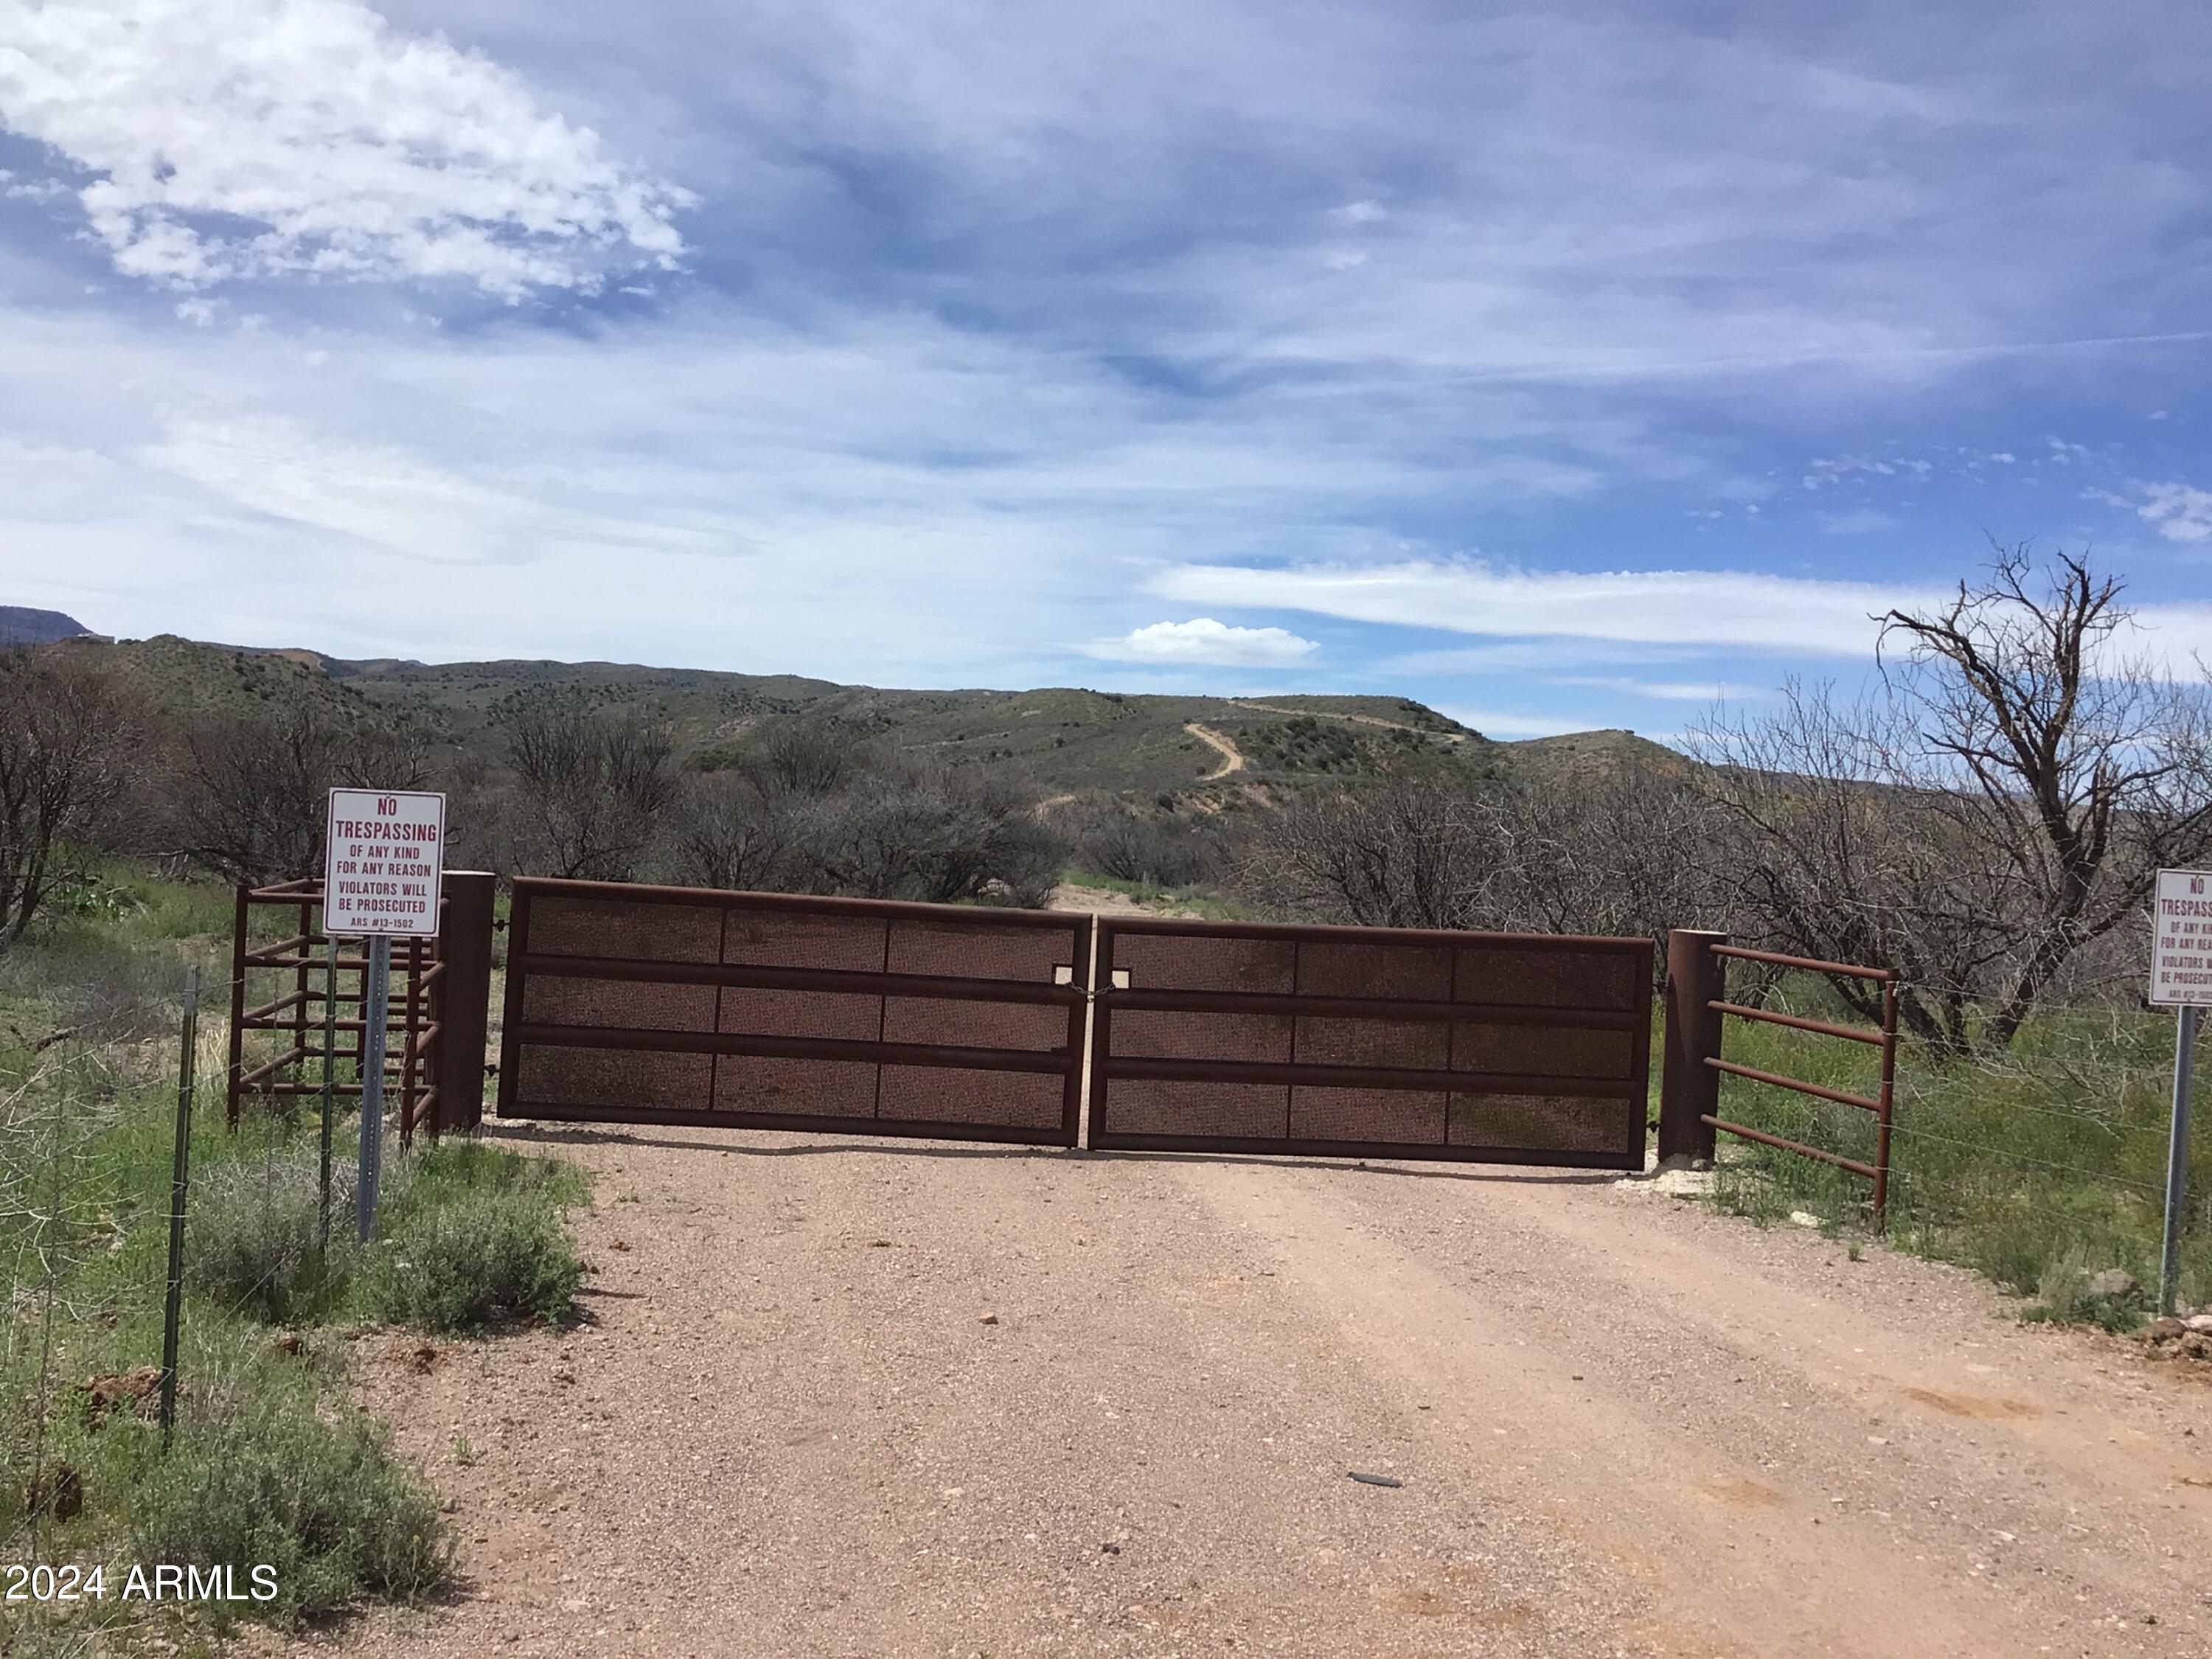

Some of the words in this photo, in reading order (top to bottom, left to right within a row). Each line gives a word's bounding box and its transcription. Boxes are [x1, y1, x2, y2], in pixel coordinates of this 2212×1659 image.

[378, 799, 397, 816] NO
[335, 821, 437, 842] TRESPASSING
[349, 844, 363, 858] OF
[368, 846, 389, 858] ANY
[394, 846, 420, 860] KIND
[337, 861, 357, 874] FOR
[362, 863, 383, 875] ANY
[389, 863, 431, 877] REASON
[338, 881, 397, 895] VIOLATORS
[403, 883, 427, 897] WILL
[2190, 878, 2204, 894] NO
[338, 898, 352, 911] BE
[357, 899, 425, 913] PROSECUTED
[351, 917, 368, 927] ARS
[372, 918, 414, 928] #13-1502
[2171, 921, 2180, 933] OF
[2183, 922, 2199, 934] ANY
[2160, 936, 2175, 948] FOR
[2179, 937, 2194, 950] ANY
[2162, 956, 2203, 969] VIOLATORS
[2161, 972, 2171, 984] BE
